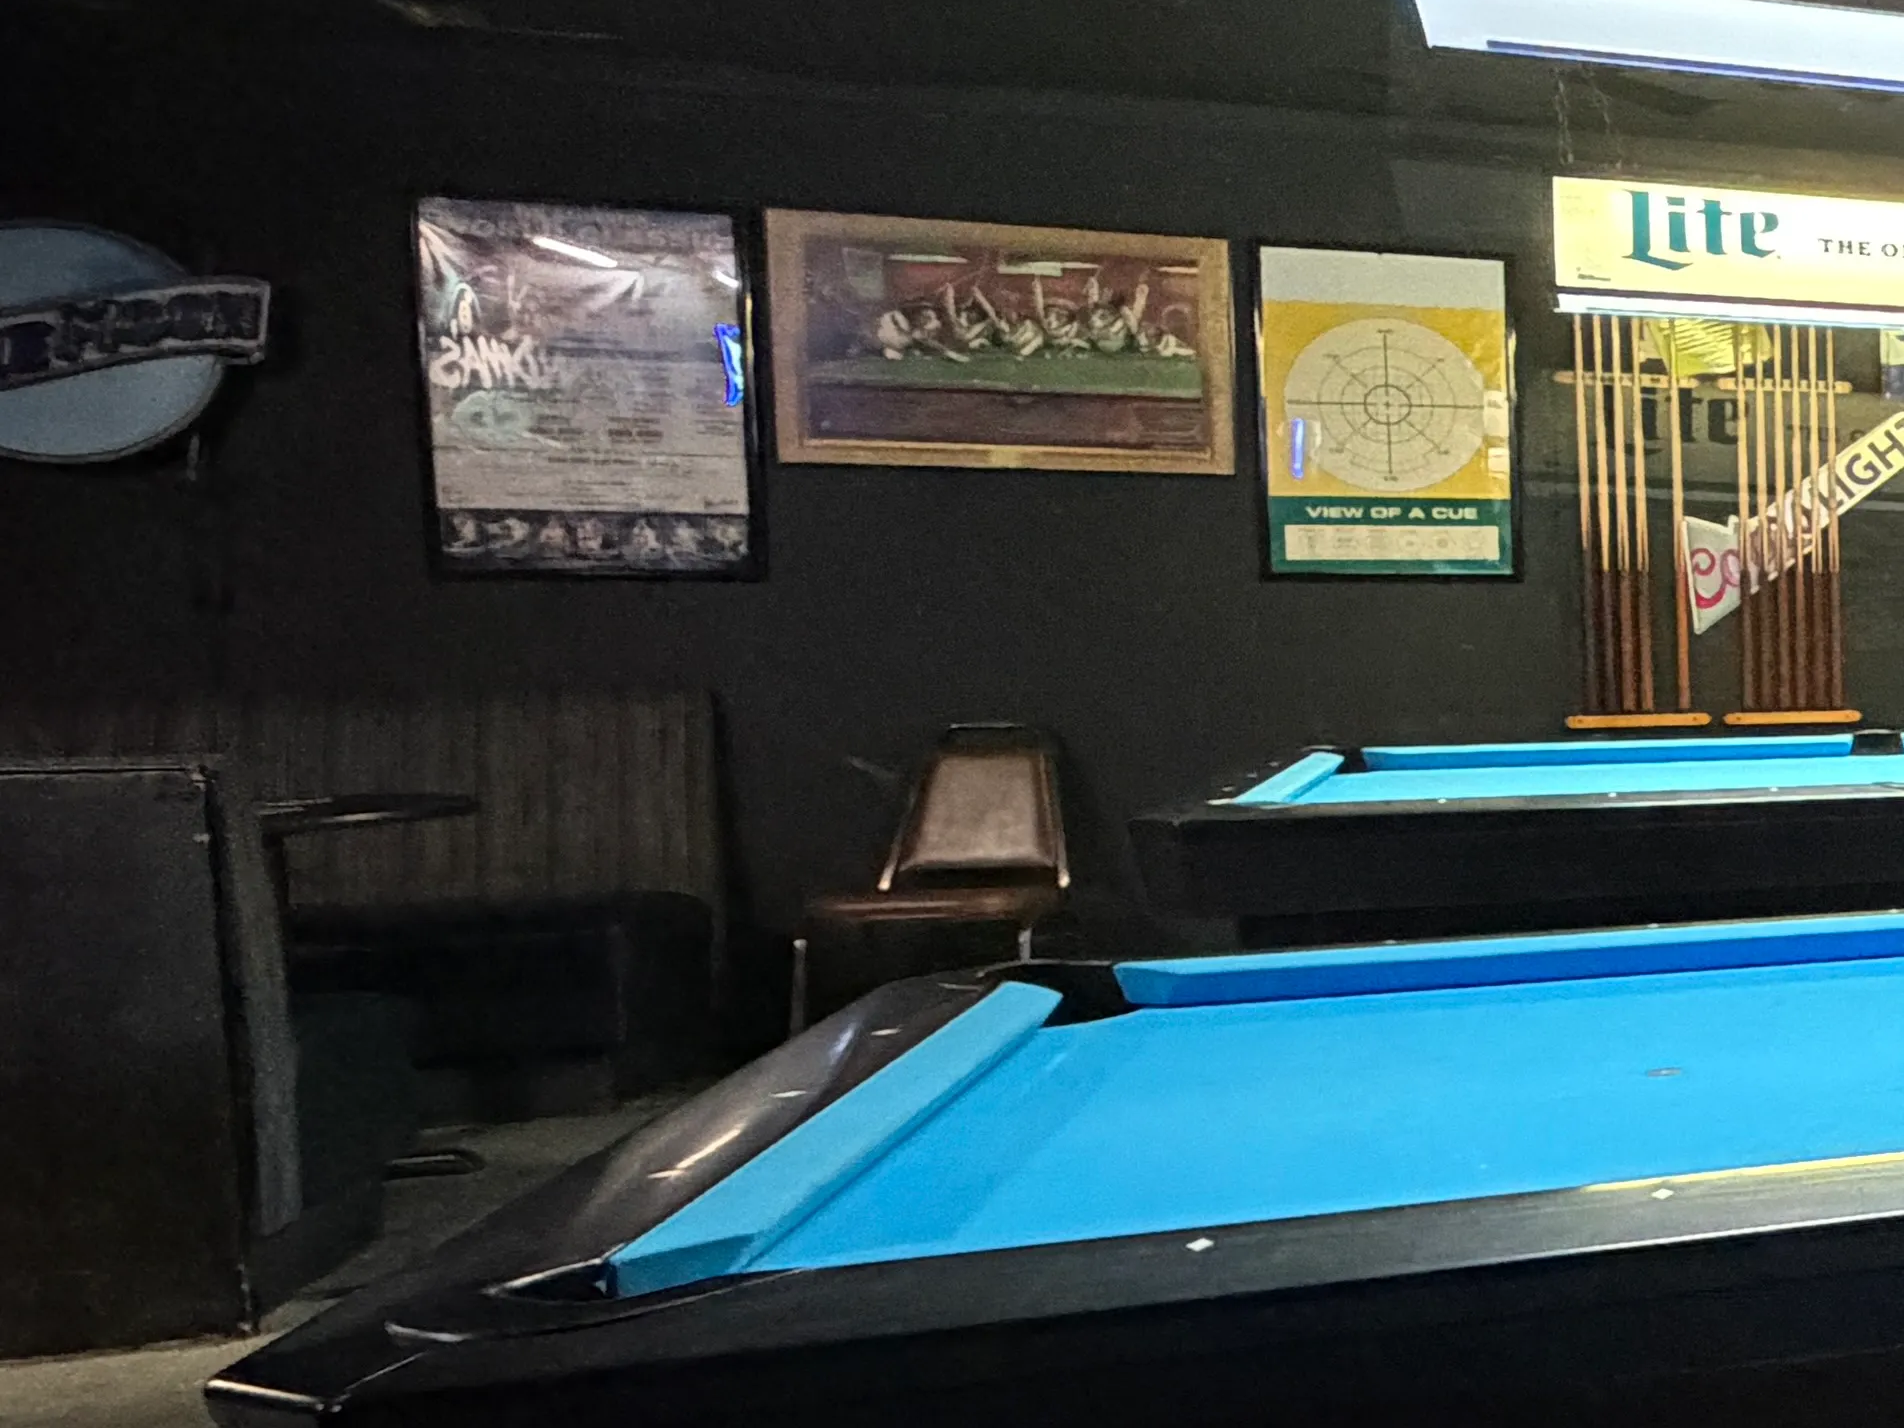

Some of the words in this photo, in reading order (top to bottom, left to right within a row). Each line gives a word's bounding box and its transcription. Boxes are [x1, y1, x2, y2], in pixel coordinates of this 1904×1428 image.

[1621, 188, 1780, 271] Lite
[1817, 237, 1871, 257] THE
[1305, 505, 1364, 519] VIEW
[1370, 506, 1402, 519] OF
[1408, 507, 1426, 520] A
[1431, 507, 1478, 520] CUE
